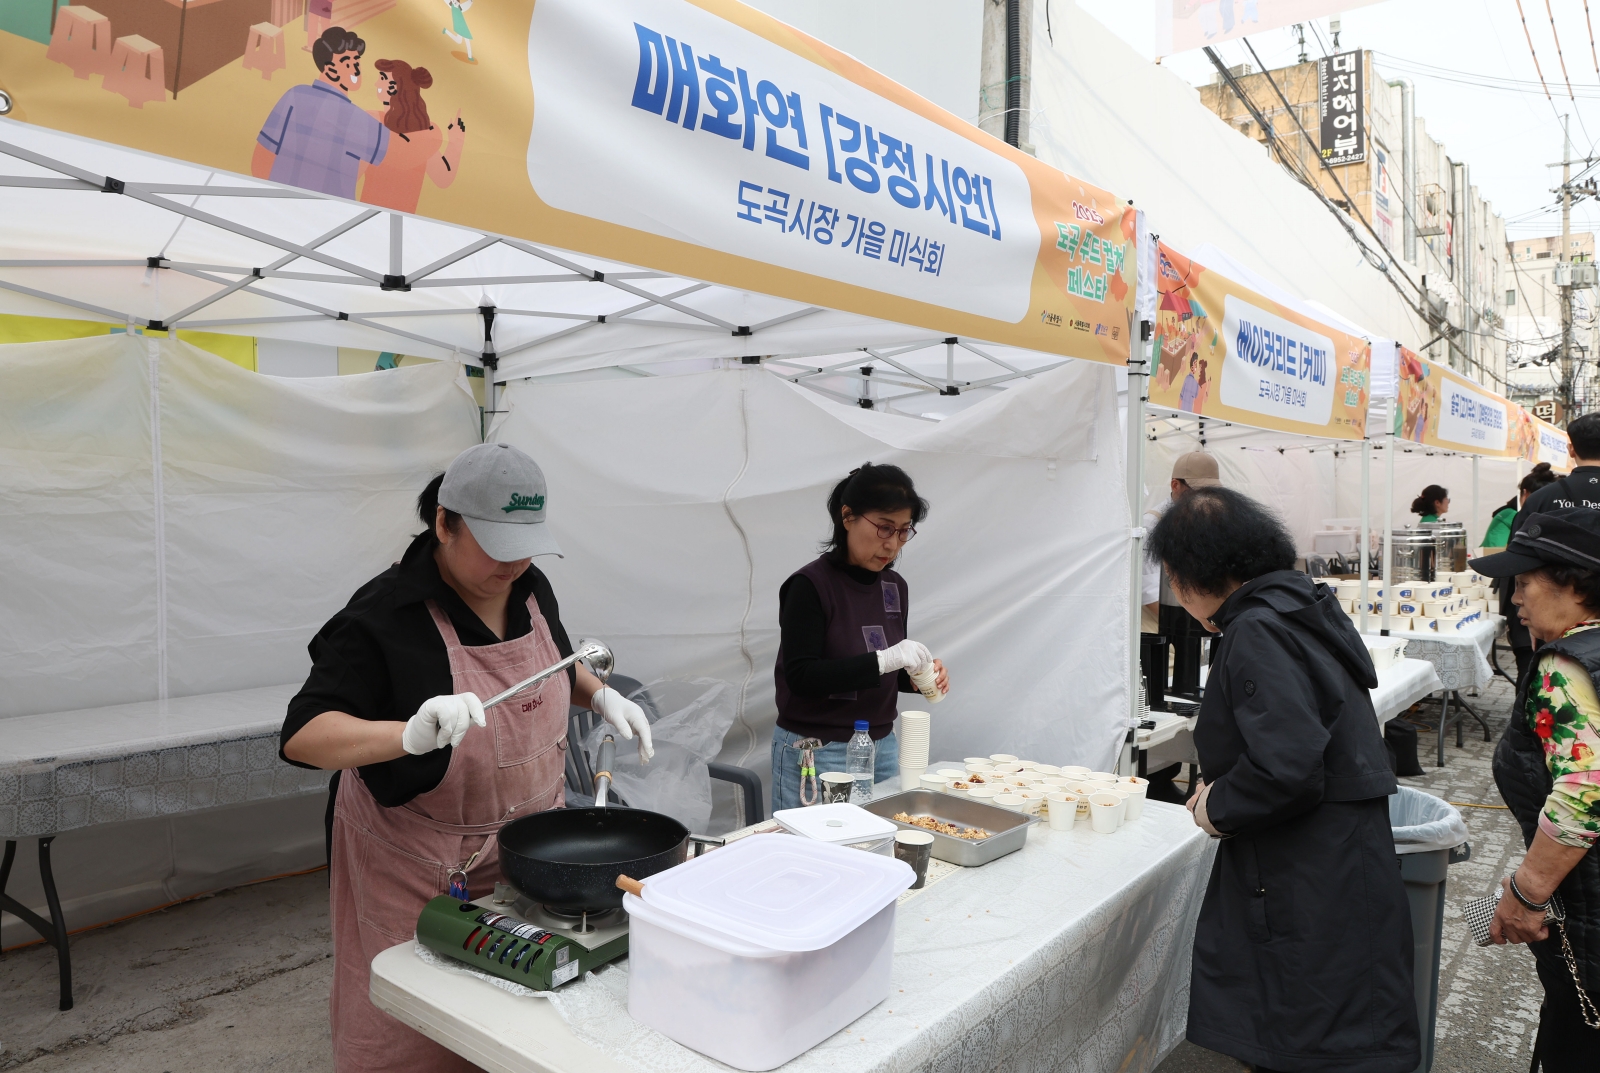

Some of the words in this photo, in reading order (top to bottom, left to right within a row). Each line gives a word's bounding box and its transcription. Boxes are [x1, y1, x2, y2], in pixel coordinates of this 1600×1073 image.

[631, 21, 809, 171] 매화연
[1332, 52, 1358, 156] 대치헤어뷰
[1321, 148, 1333, 158] 2F
[736, 179, 839, 245] 도곡시장
[841, 213, 886, 260] 가을
[888, 228, 946, 277] 미식회
[1072, 201, 1104, 225] 2025
[1054, 221, 1081, 262] 도곡
[1067, 265, 1108, 303] 페스타
[1535, 402, 1557, 424] 떡
[509, 492, 545, 507] Sunday
